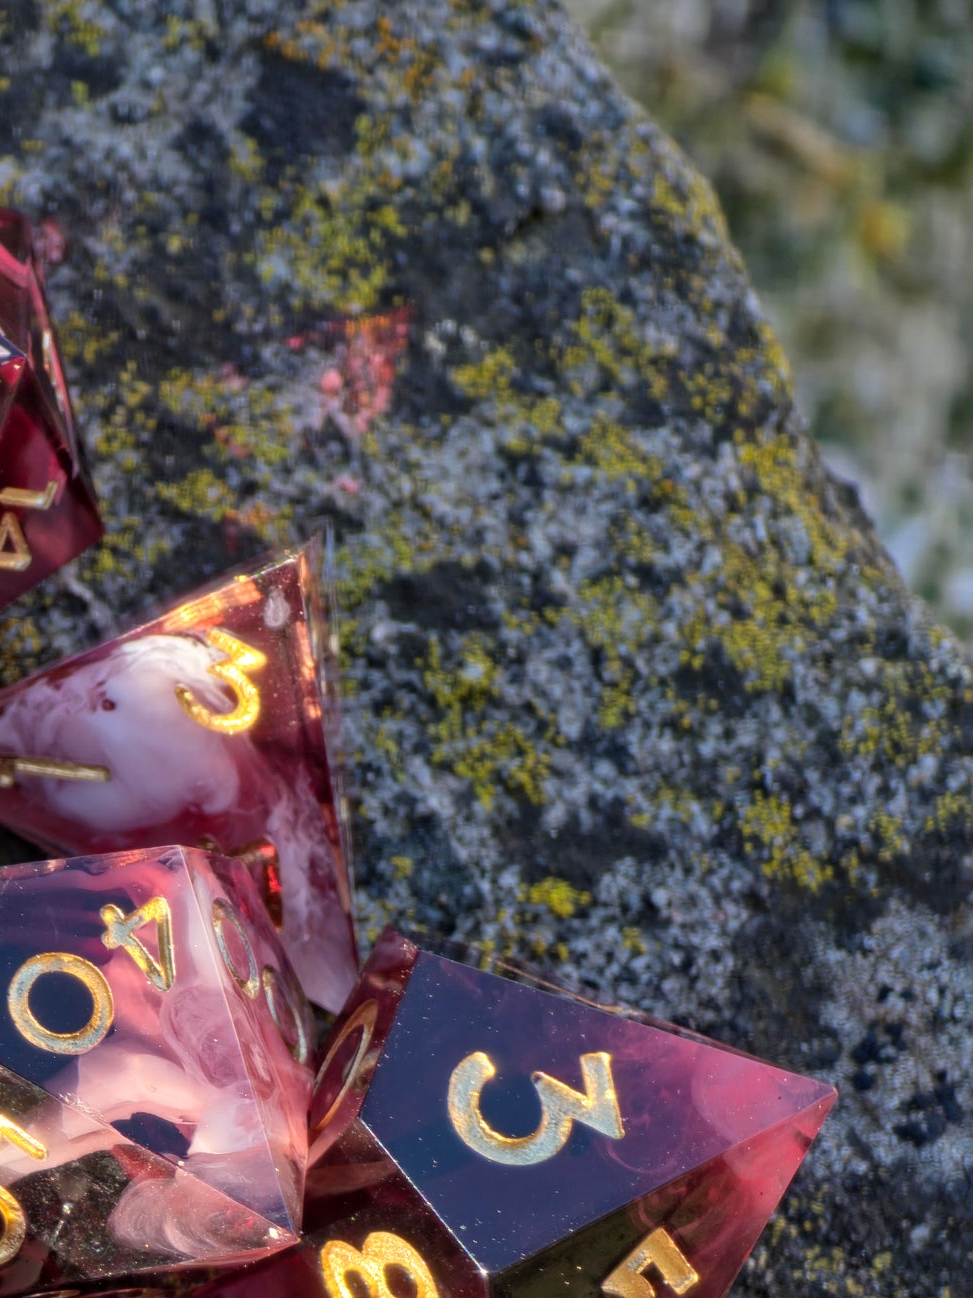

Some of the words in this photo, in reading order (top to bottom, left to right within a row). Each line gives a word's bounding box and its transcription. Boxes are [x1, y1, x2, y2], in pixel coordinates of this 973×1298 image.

[174, 628, 268, 735] 3
[8, 896, 177, 1055] 40
[447, 1050, 625, 1166] 3
